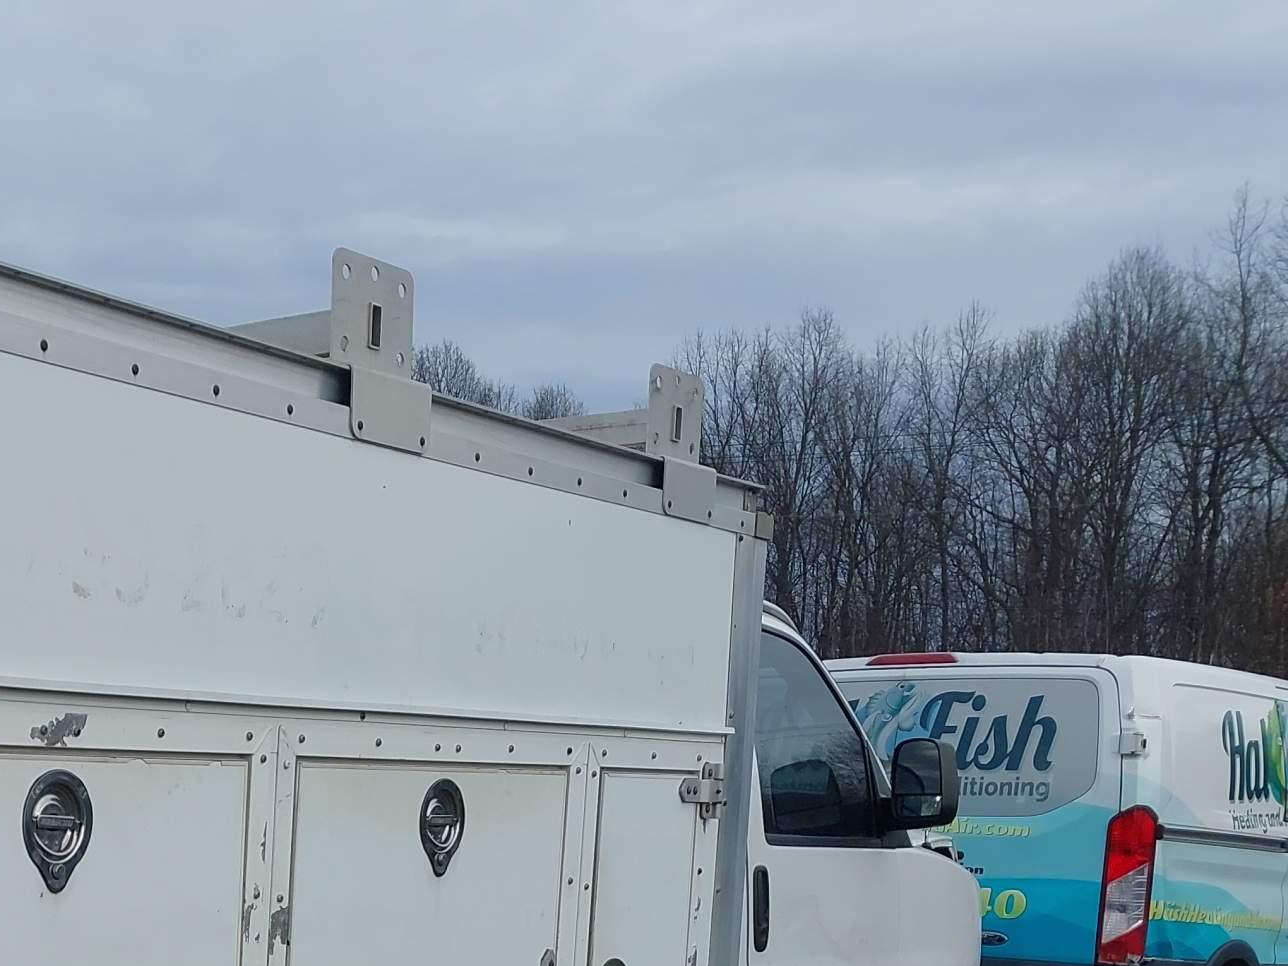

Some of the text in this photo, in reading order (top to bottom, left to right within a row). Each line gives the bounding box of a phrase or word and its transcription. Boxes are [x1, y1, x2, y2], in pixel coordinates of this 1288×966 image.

[920, 690, 1057, 771] Fish
[1221, 709, 1270, 801] Hal
[958, 776, 1050, 801] itioning
